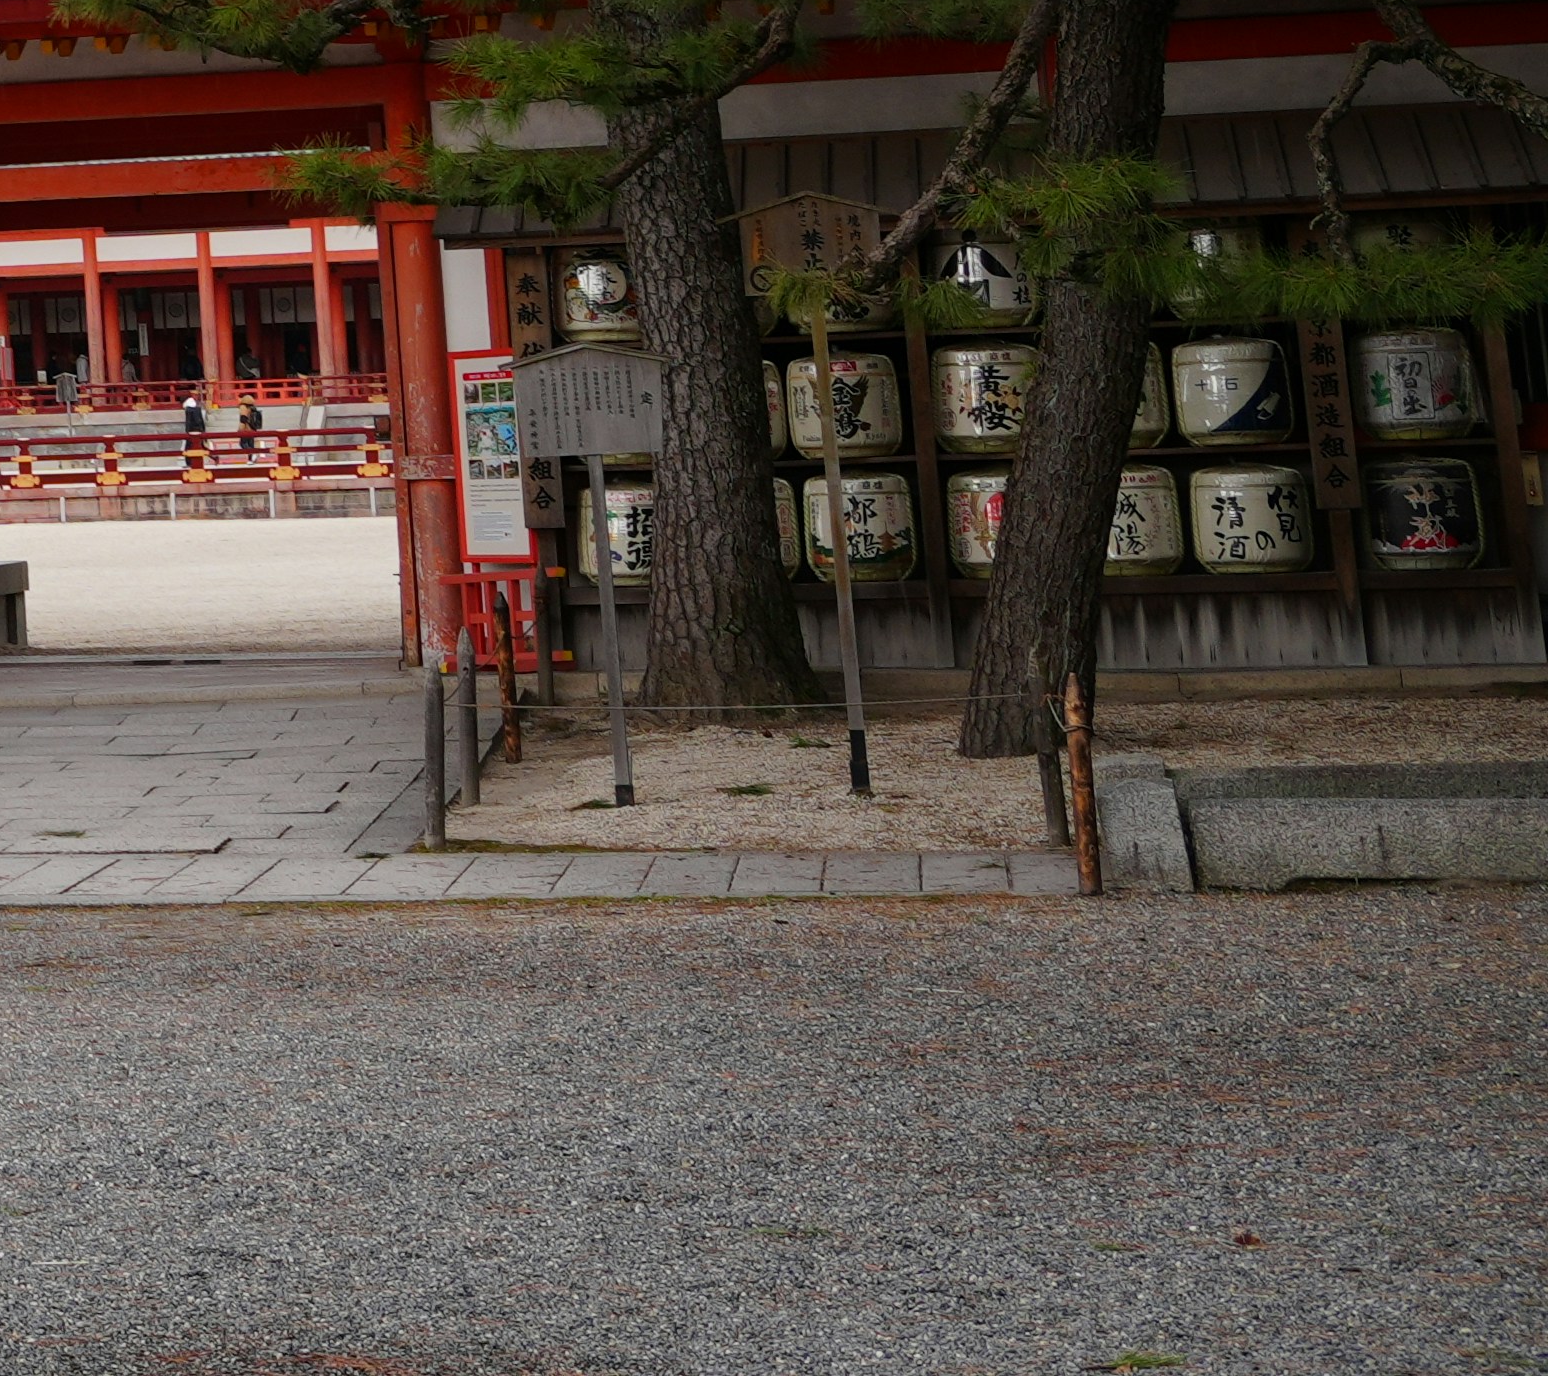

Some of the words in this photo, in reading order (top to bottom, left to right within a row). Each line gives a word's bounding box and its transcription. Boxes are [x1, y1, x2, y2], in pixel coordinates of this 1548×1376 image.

[801, 228, 827, 273] 禁止
[515, 273, 543, 326] 奉献
[528, 408, 540, 450] 平安神宮
[528, 458, 556, 510] 組合
[1211, 496, 1250, 560] 清酒
[1256, 530, 1275, 550] の
[1267, 485, 1303, 543] 伏見
